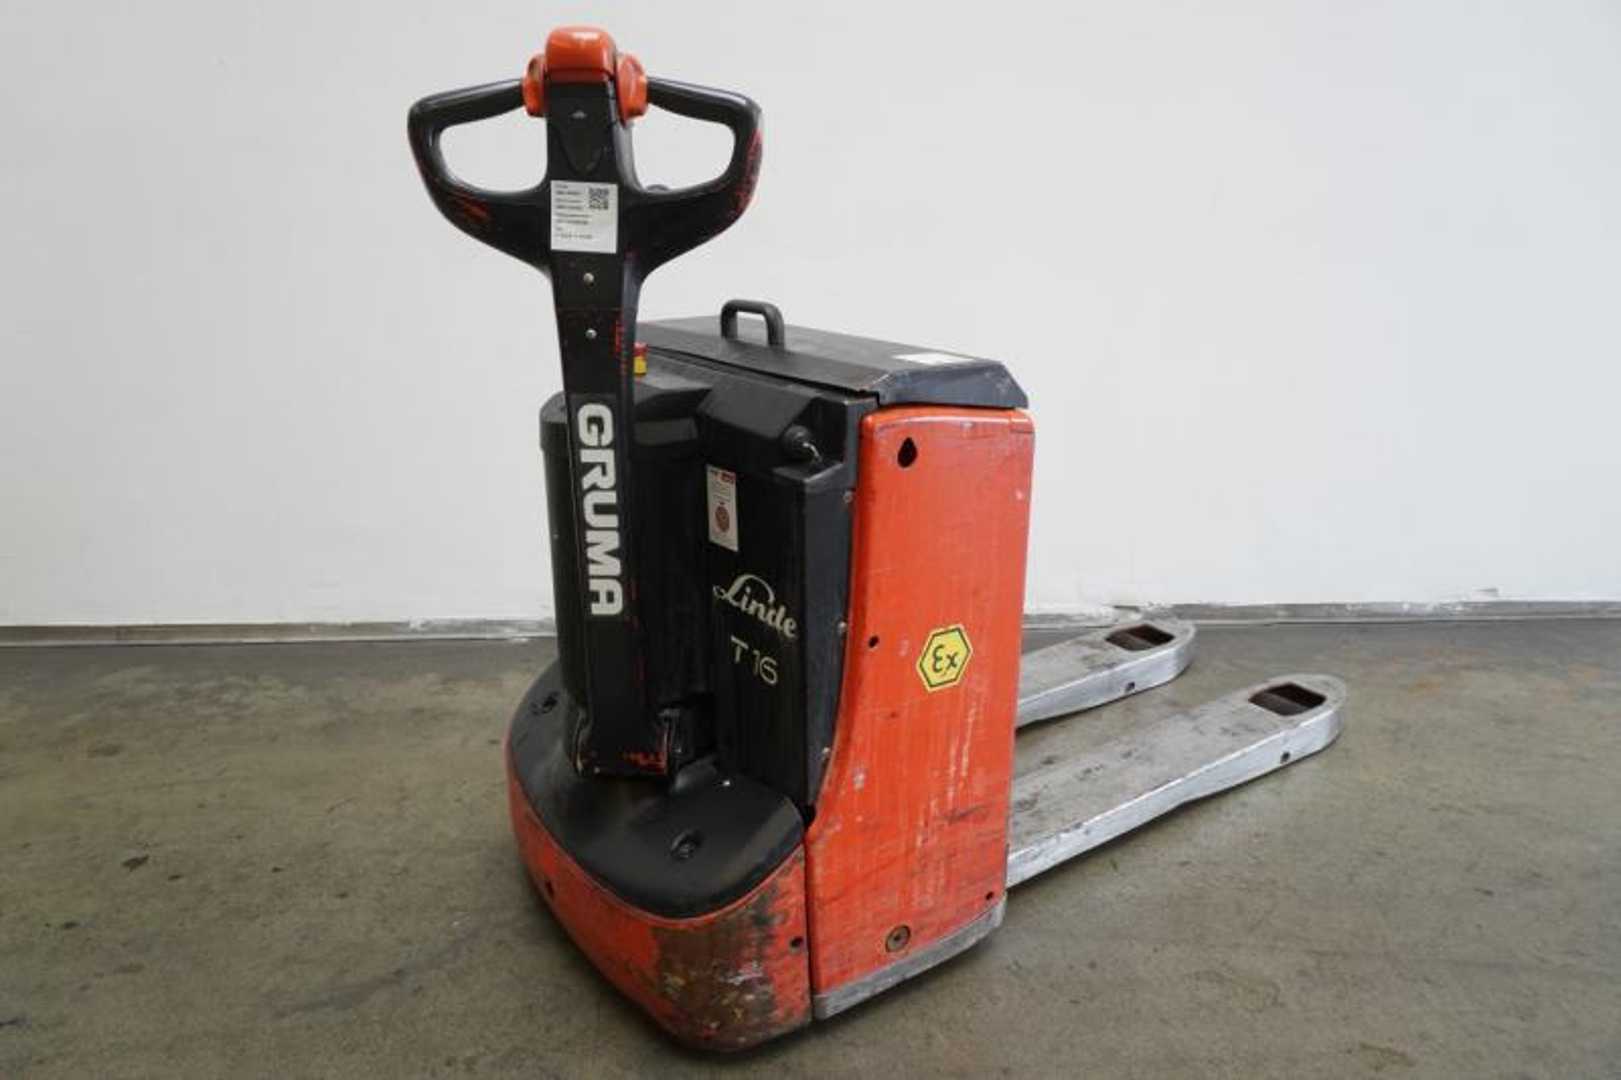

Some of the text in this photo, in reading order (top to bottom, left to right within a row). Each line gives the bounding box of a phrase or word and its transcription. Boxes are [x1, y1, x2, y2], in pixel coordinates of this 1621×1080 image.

[577, 403, 623, 615] GRUMA
[713, 574, 798, 638] Linde
[730, 635, 749, 663] T
[932, 644, 959, 673] Ex
